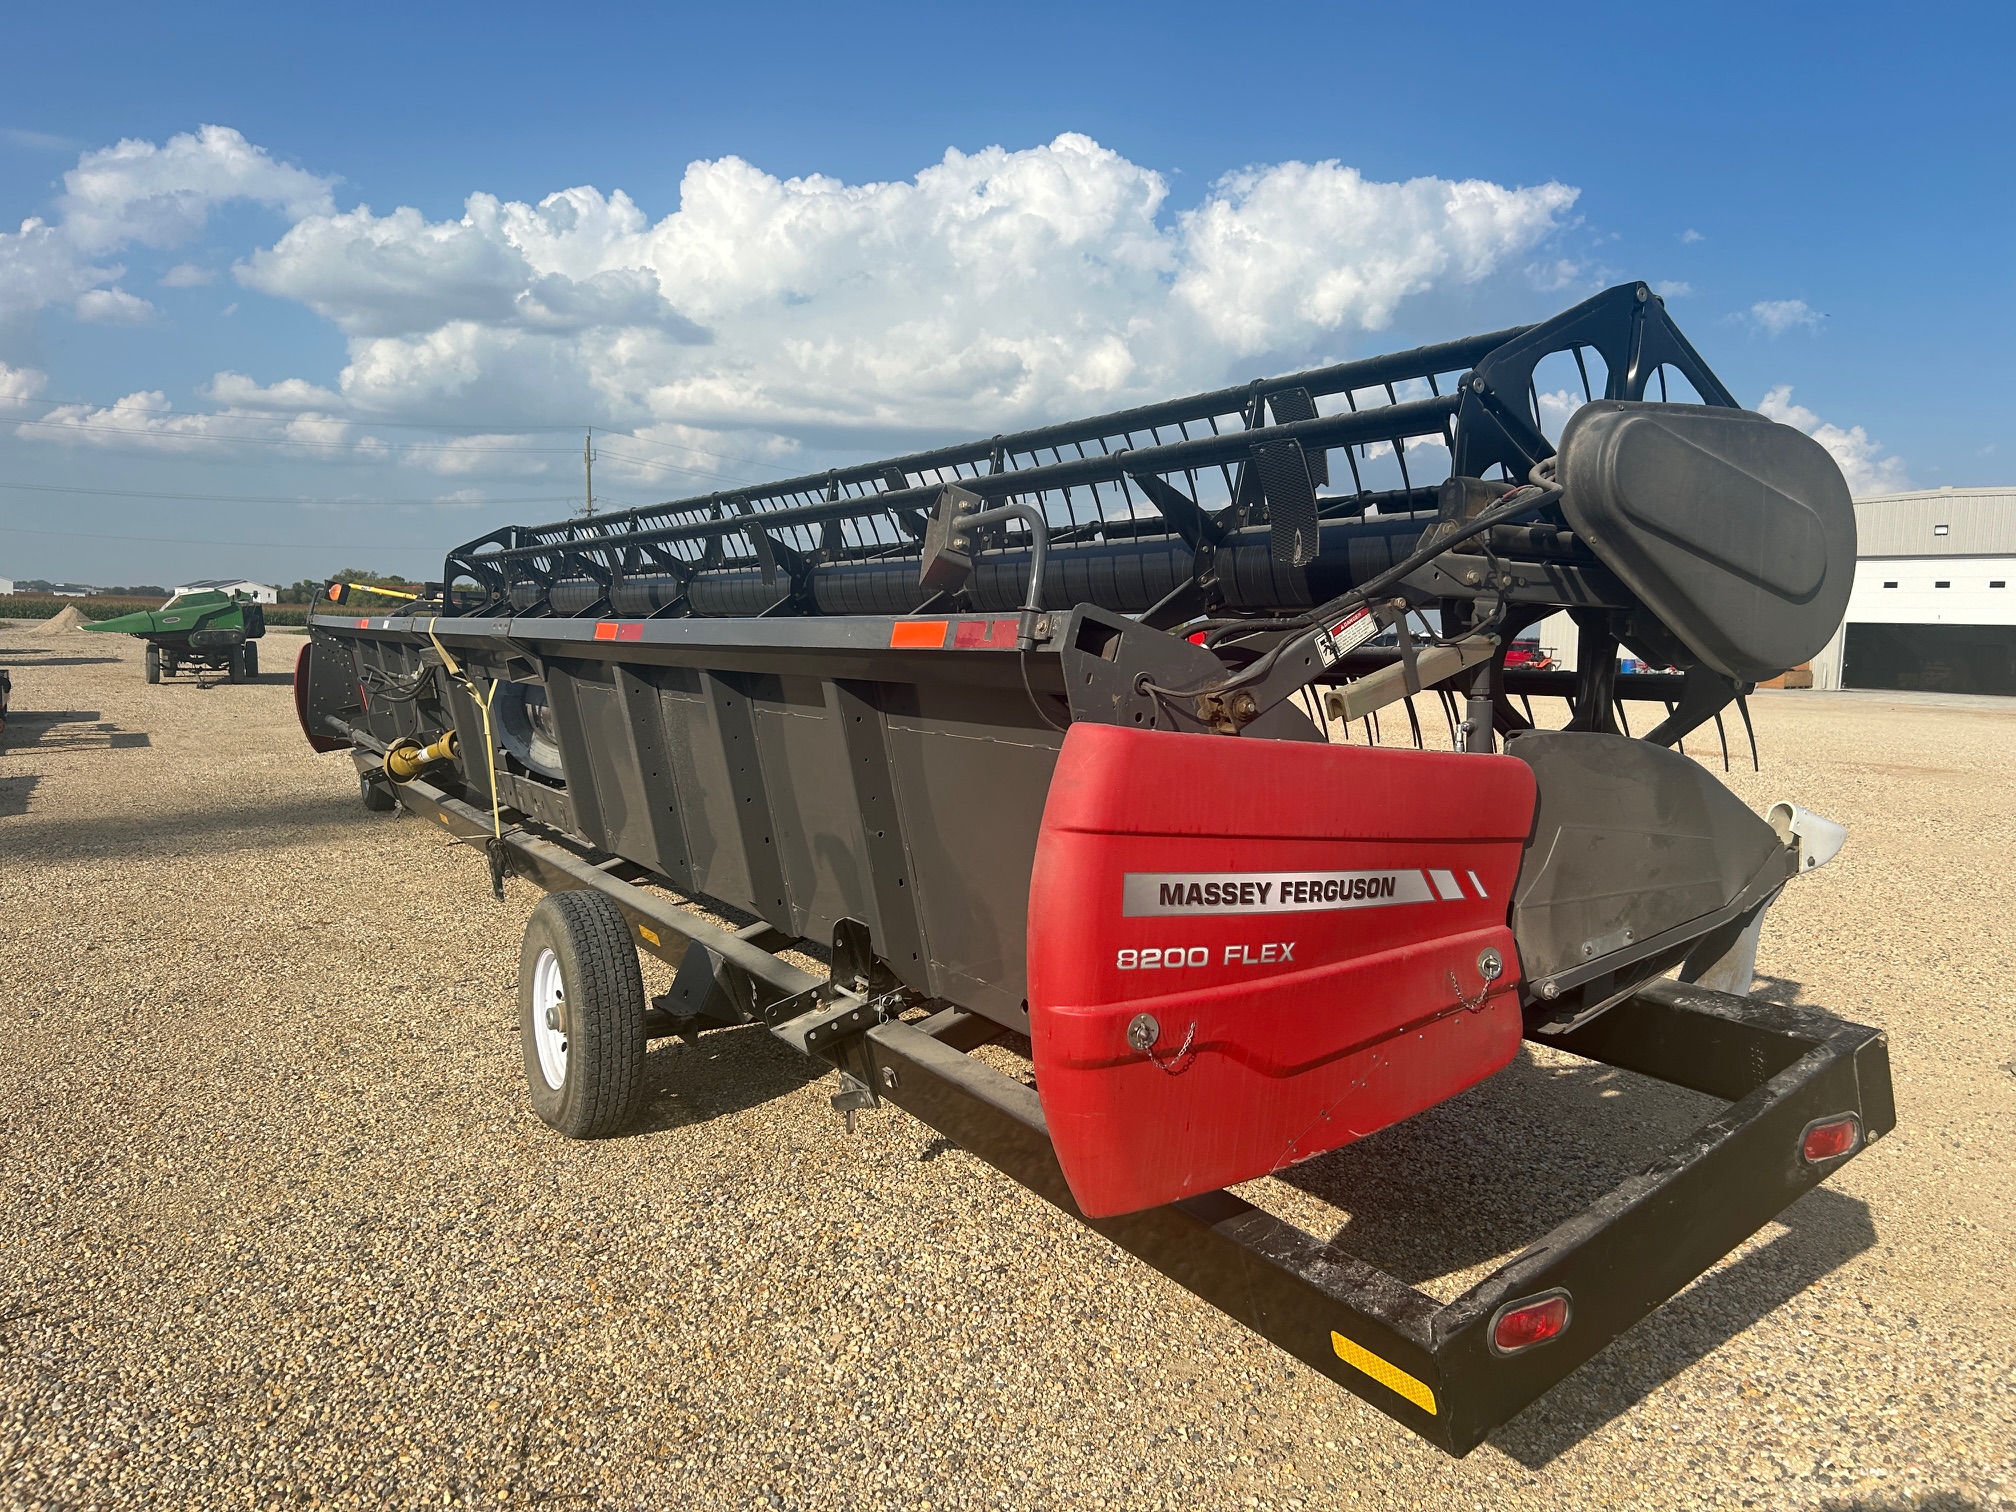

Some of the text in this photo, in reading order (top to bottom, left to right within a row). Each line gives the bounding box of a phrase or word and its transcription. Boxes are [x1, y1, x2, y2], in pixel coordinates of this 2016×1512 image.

[1159, 877, 1396, 906] MASSEY FERGUSON
[1117, 942, 1296, 969] 8200 FLEX
